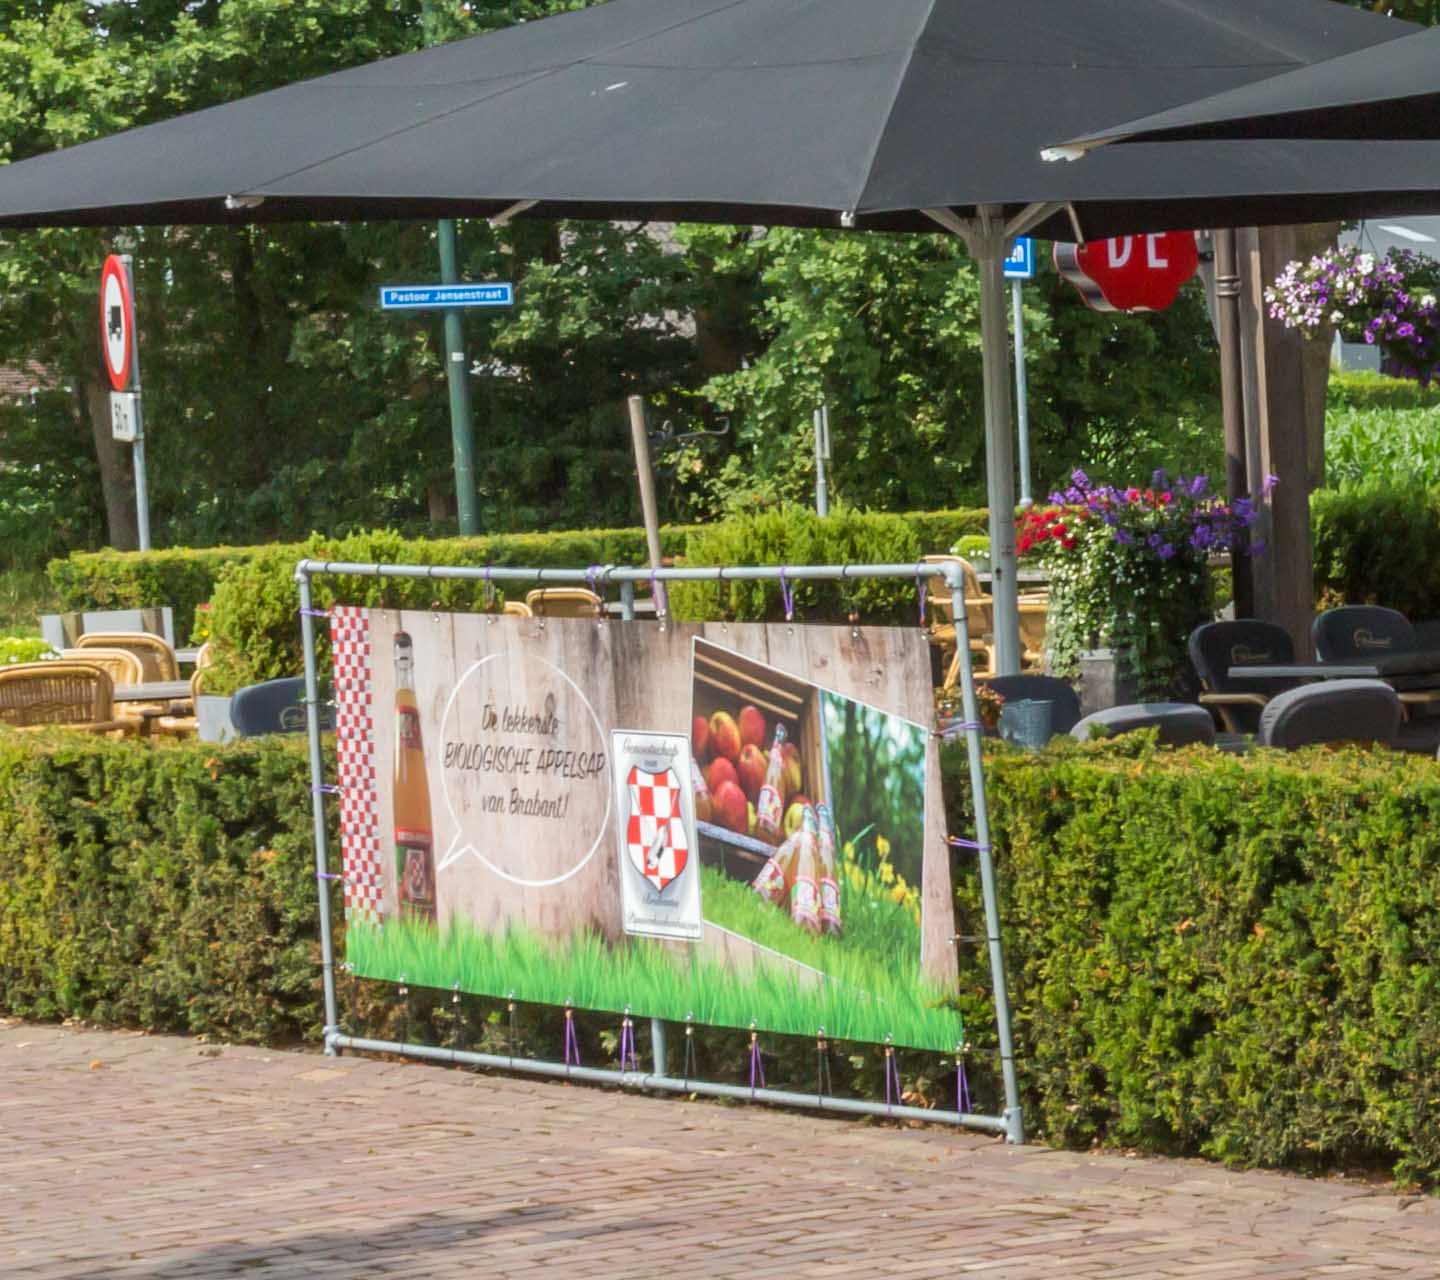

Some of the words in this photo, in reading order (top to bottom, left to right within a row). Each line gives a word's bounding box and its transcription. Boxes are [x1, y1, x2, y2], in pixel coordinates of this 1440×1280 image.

[390, 291, 430, 302] Pastoor
[434, 289, 502, 301] Jansenstraat
[482, 703, 498, 732] De
[502, 705, 559, 737] lekkerste
[444, 741, 533, 775] BIOLOGISCHE
[536, 748, 606, 779] APPELSAP
[482, 793, 505, 814] van
[508, 787, 570, 818] Brabant!
